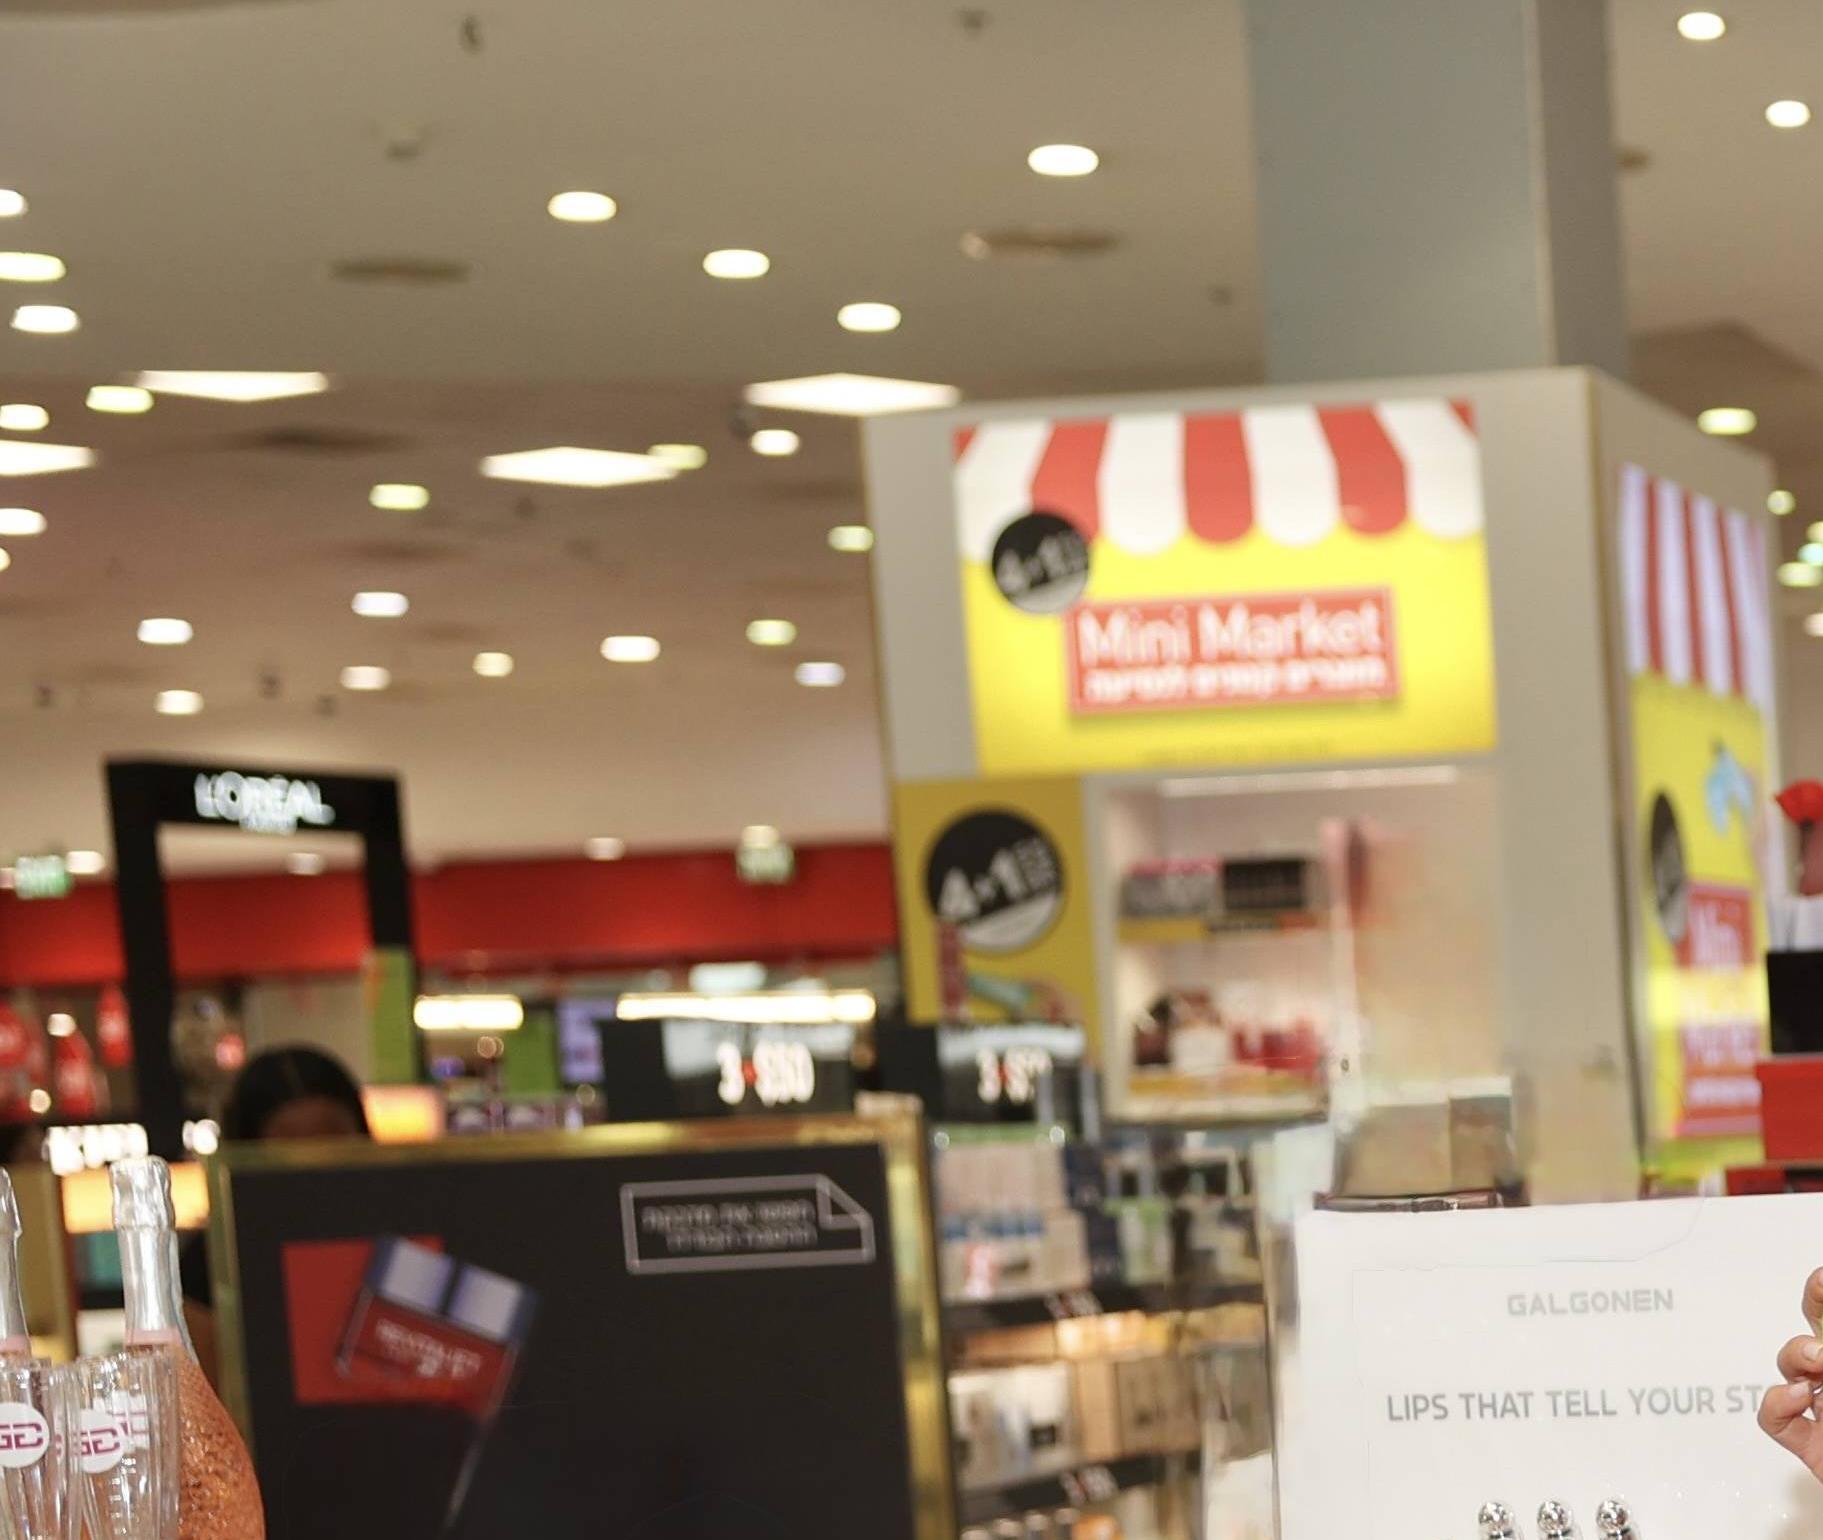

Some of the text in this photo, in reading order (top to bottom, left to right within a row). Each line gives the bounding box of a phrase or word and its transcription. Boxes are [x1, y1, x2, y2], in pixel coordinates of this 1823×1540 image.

[1078, 597, 1382, 666] Mini Market
[1507, 1288, 1674, 1317] GALGONEN
[1387, 1384, 1767, 1422] LIPS THAT TELL YOUR ST
